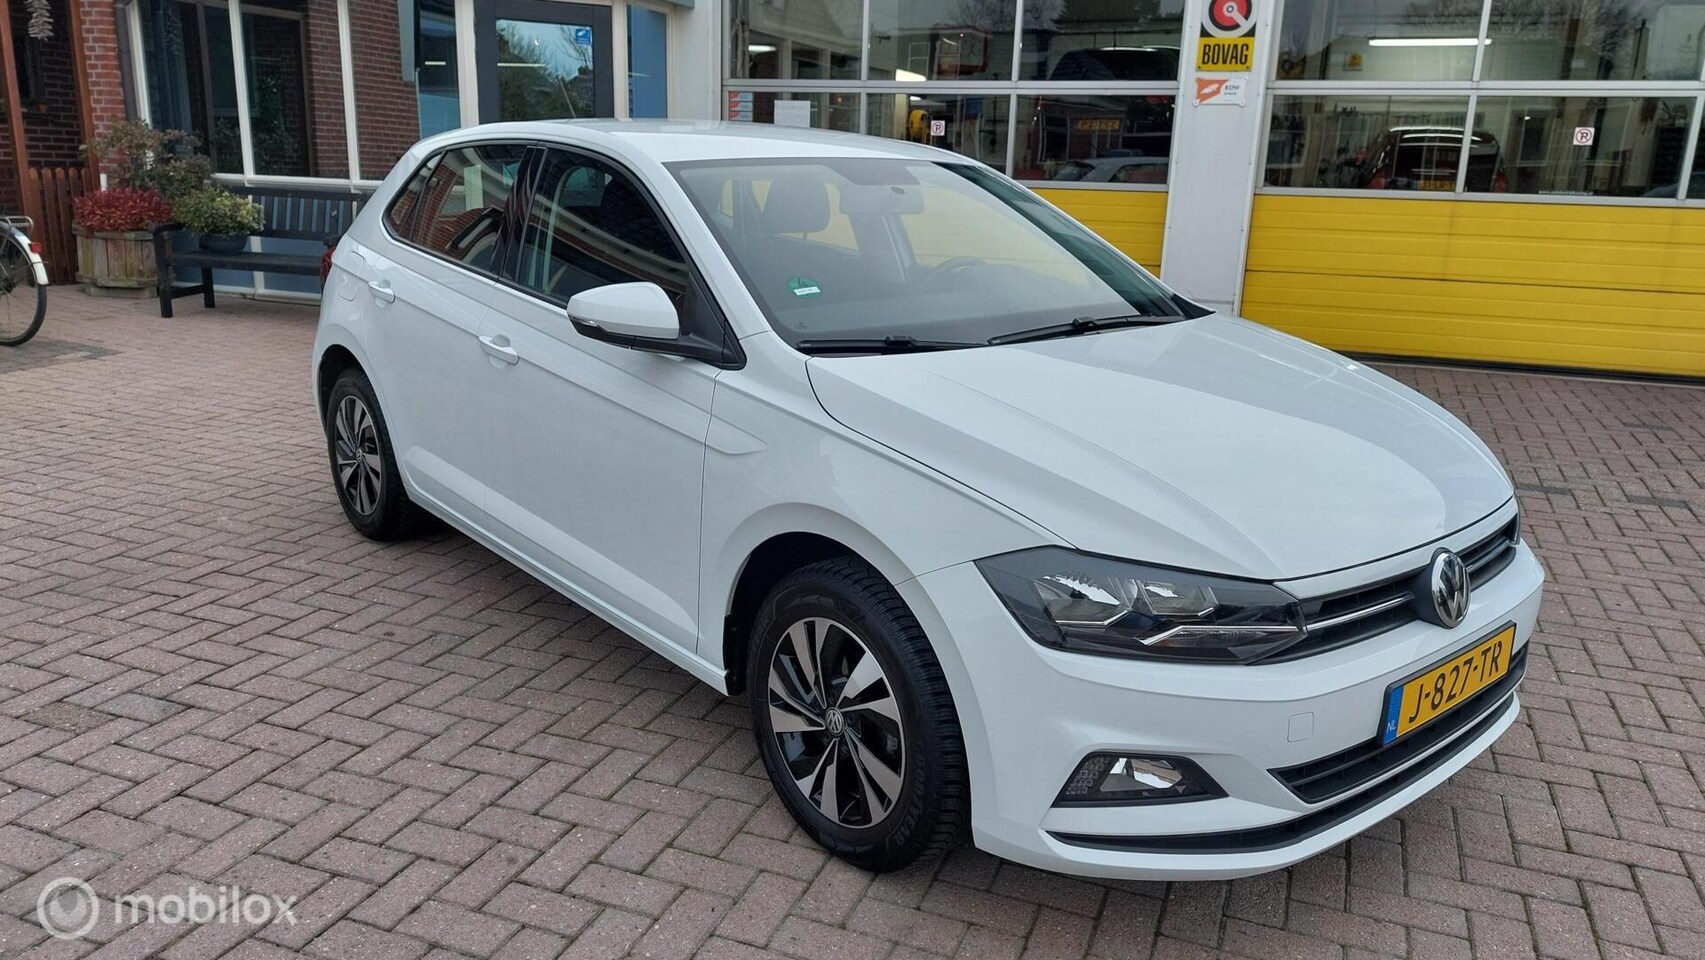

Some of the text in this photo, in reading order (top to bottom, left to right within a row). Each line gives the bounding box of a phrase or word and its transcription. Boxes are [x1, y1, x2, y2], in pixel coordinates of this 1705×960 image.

[1202, 44, 1249, 65] BOVAG
[1408, 640, 1503, 724] J-827-TR
[1386, 720, 1397, 733] NL
